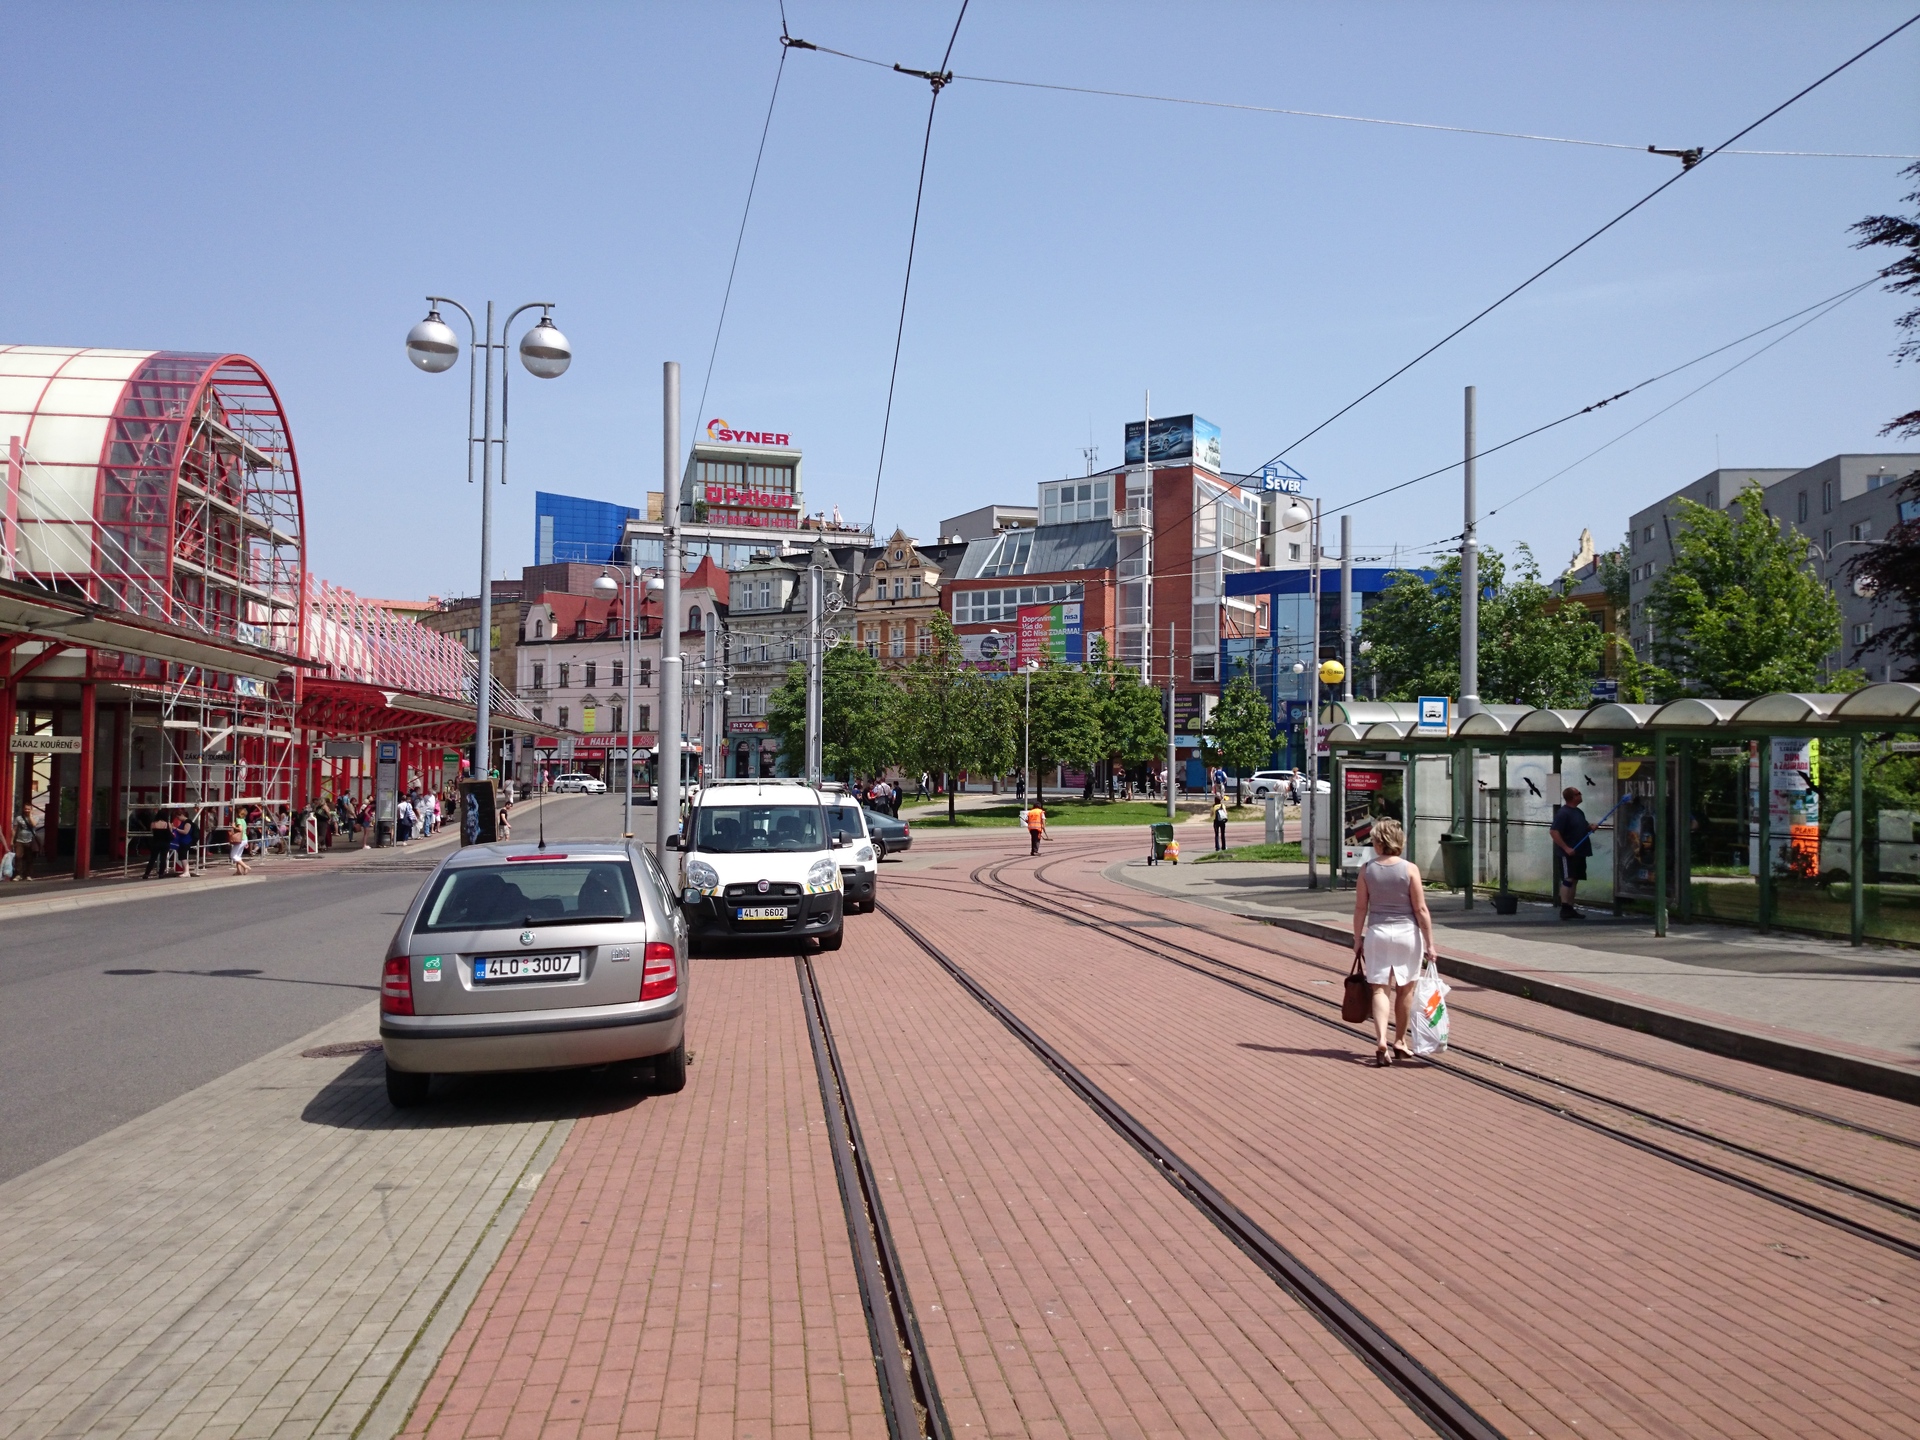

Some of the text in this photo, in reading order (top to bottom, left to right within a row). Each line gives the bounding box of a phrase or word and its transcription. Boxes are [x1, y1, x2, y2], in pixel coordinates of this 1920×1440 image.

[718, 429, 789, 446] SYNER
[1265, 475, 1301, 492] SEVER
[726, 488, 793, 508] Pytloun
[771, 518, 797, 529] HOTEL
[1048, 628, 1080, 636] ZDARMA!
[11, 739, 73, 749] ZÁKAZ KOUŘENÍ
[590, 737, 616, 746] HALLE
[1773, 762, 1778, 770] A
[744, 907, 785, 918] 4L1 6602
[489, 955, 572, 976] 4L0 3007
